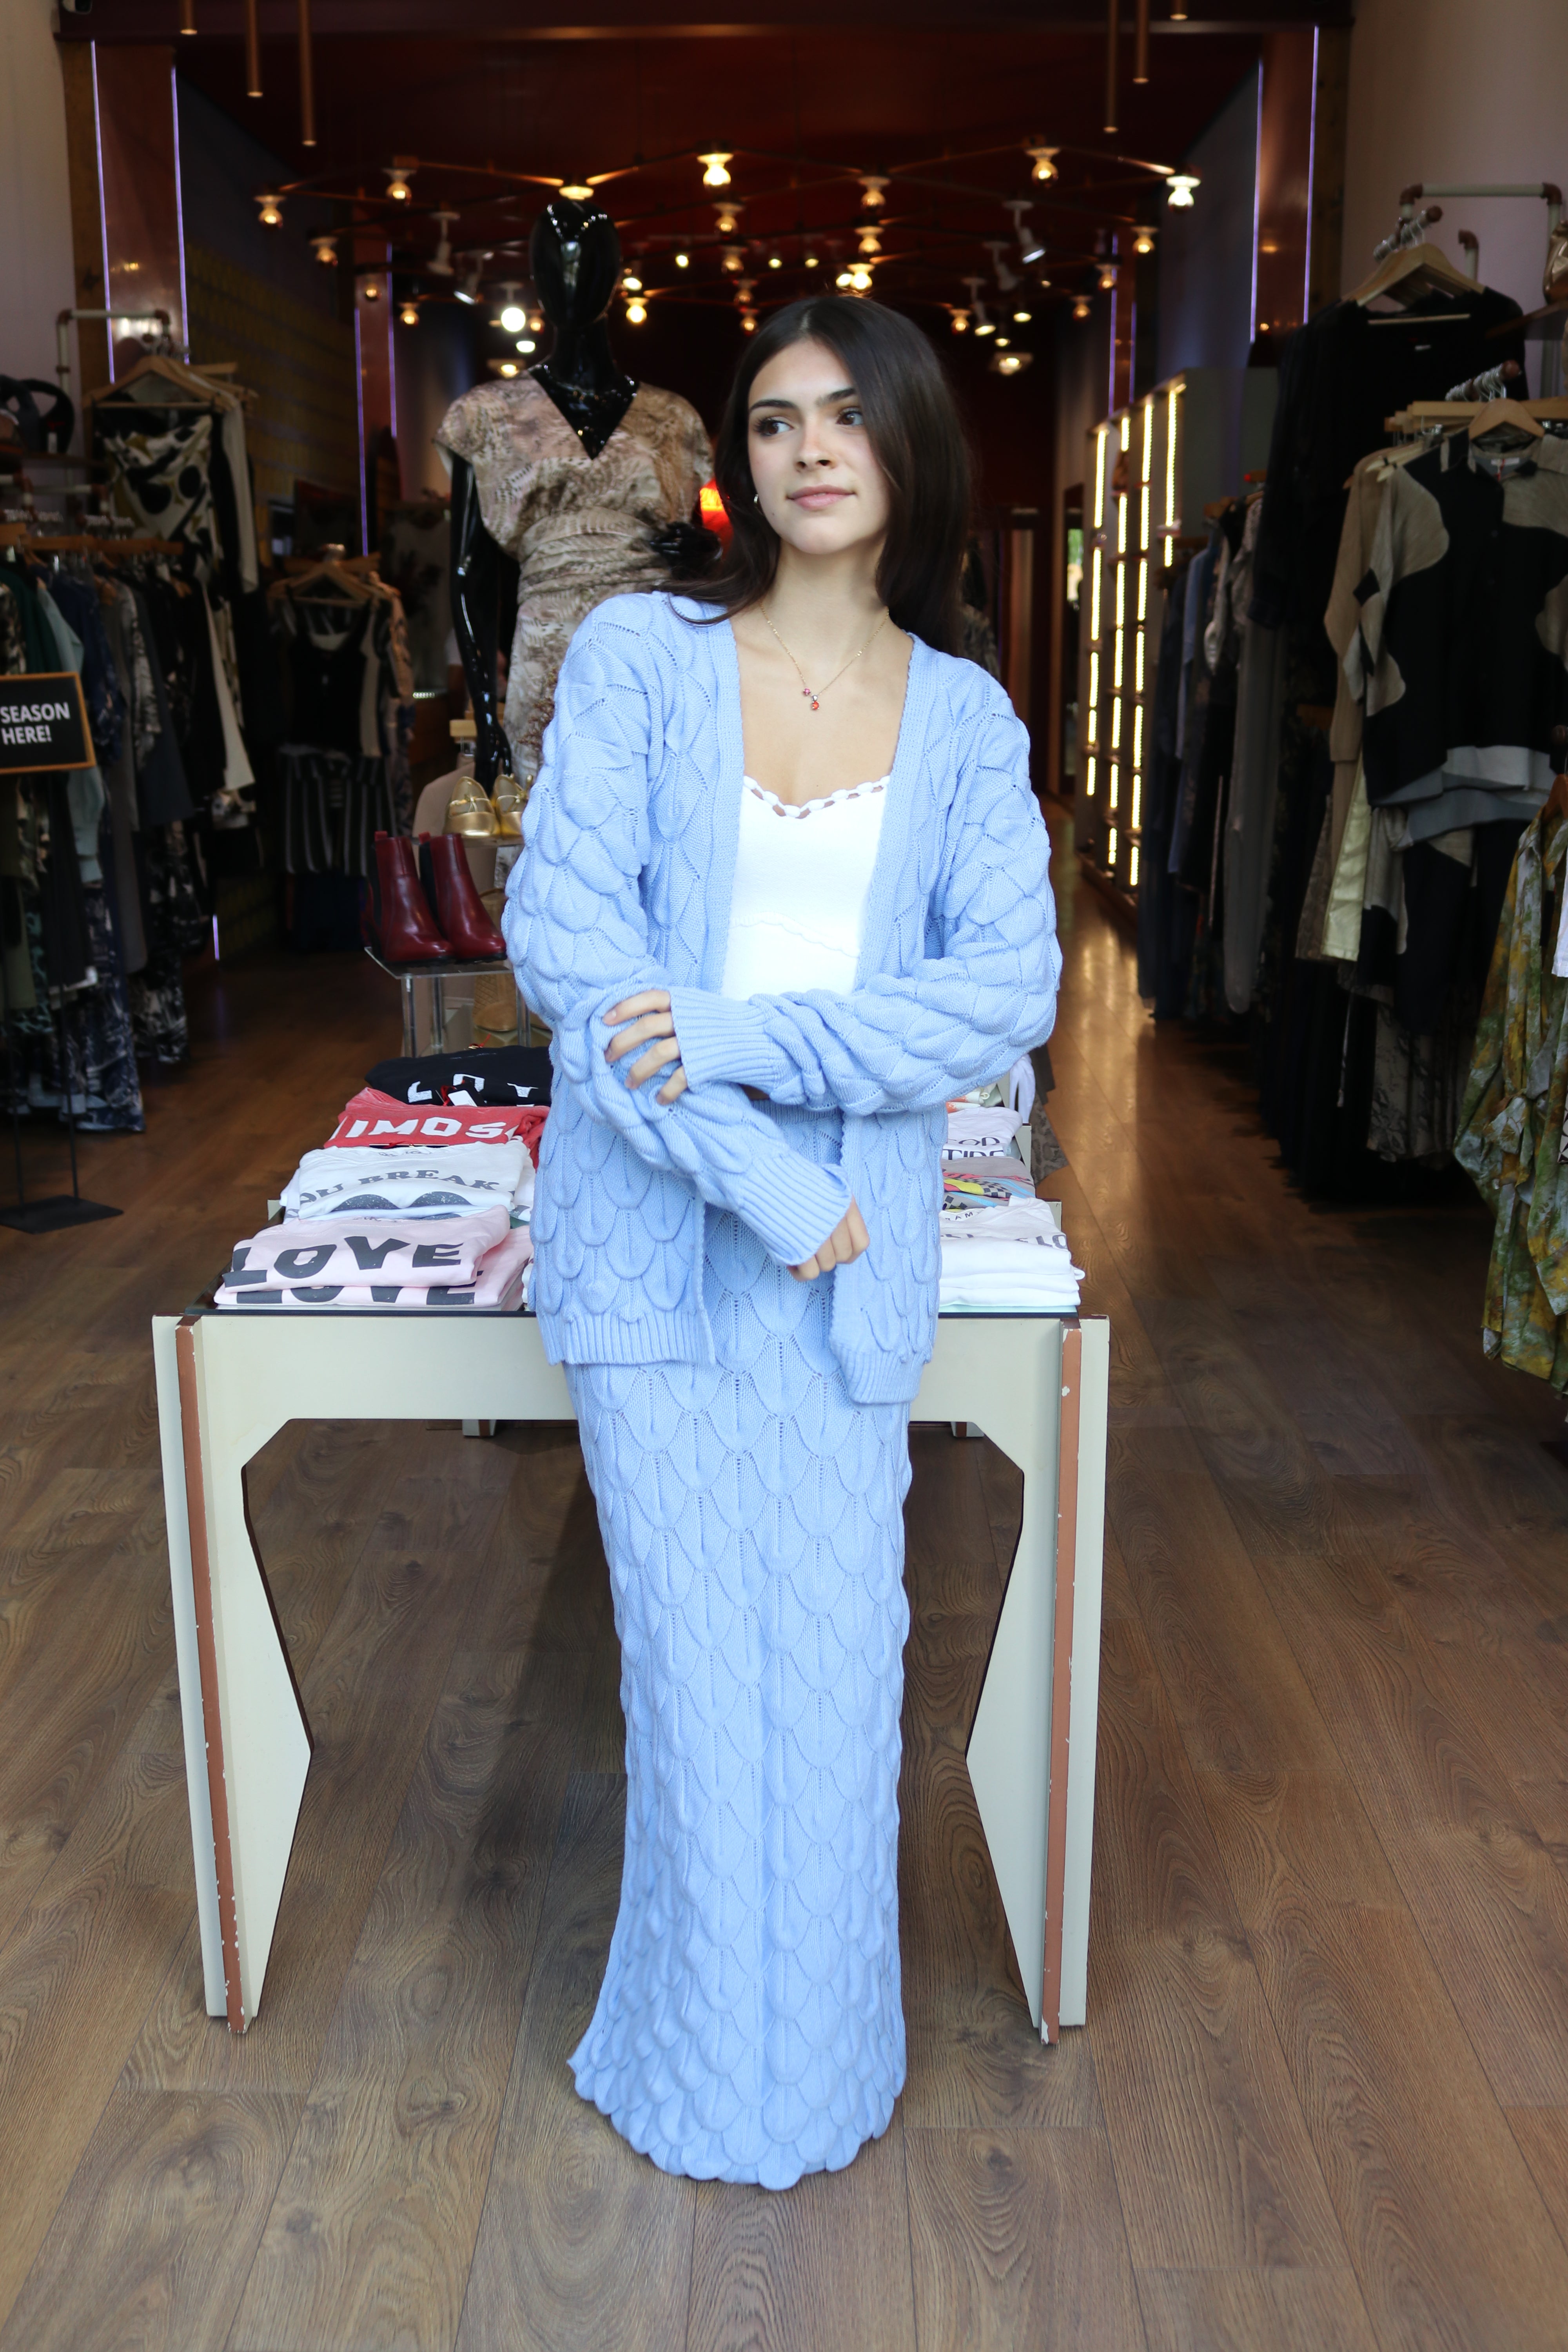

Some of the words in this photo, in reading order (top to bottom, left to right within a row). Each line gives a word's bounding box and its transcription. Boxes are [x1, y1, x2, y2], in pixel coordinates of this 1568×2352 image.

[0, 702, 71, 724] SEASON
[1, 725, 52, 744] HERE!
[360, 1170, 499, 1191] BREAK
[222, 1236, 464, 1285] LOVE
